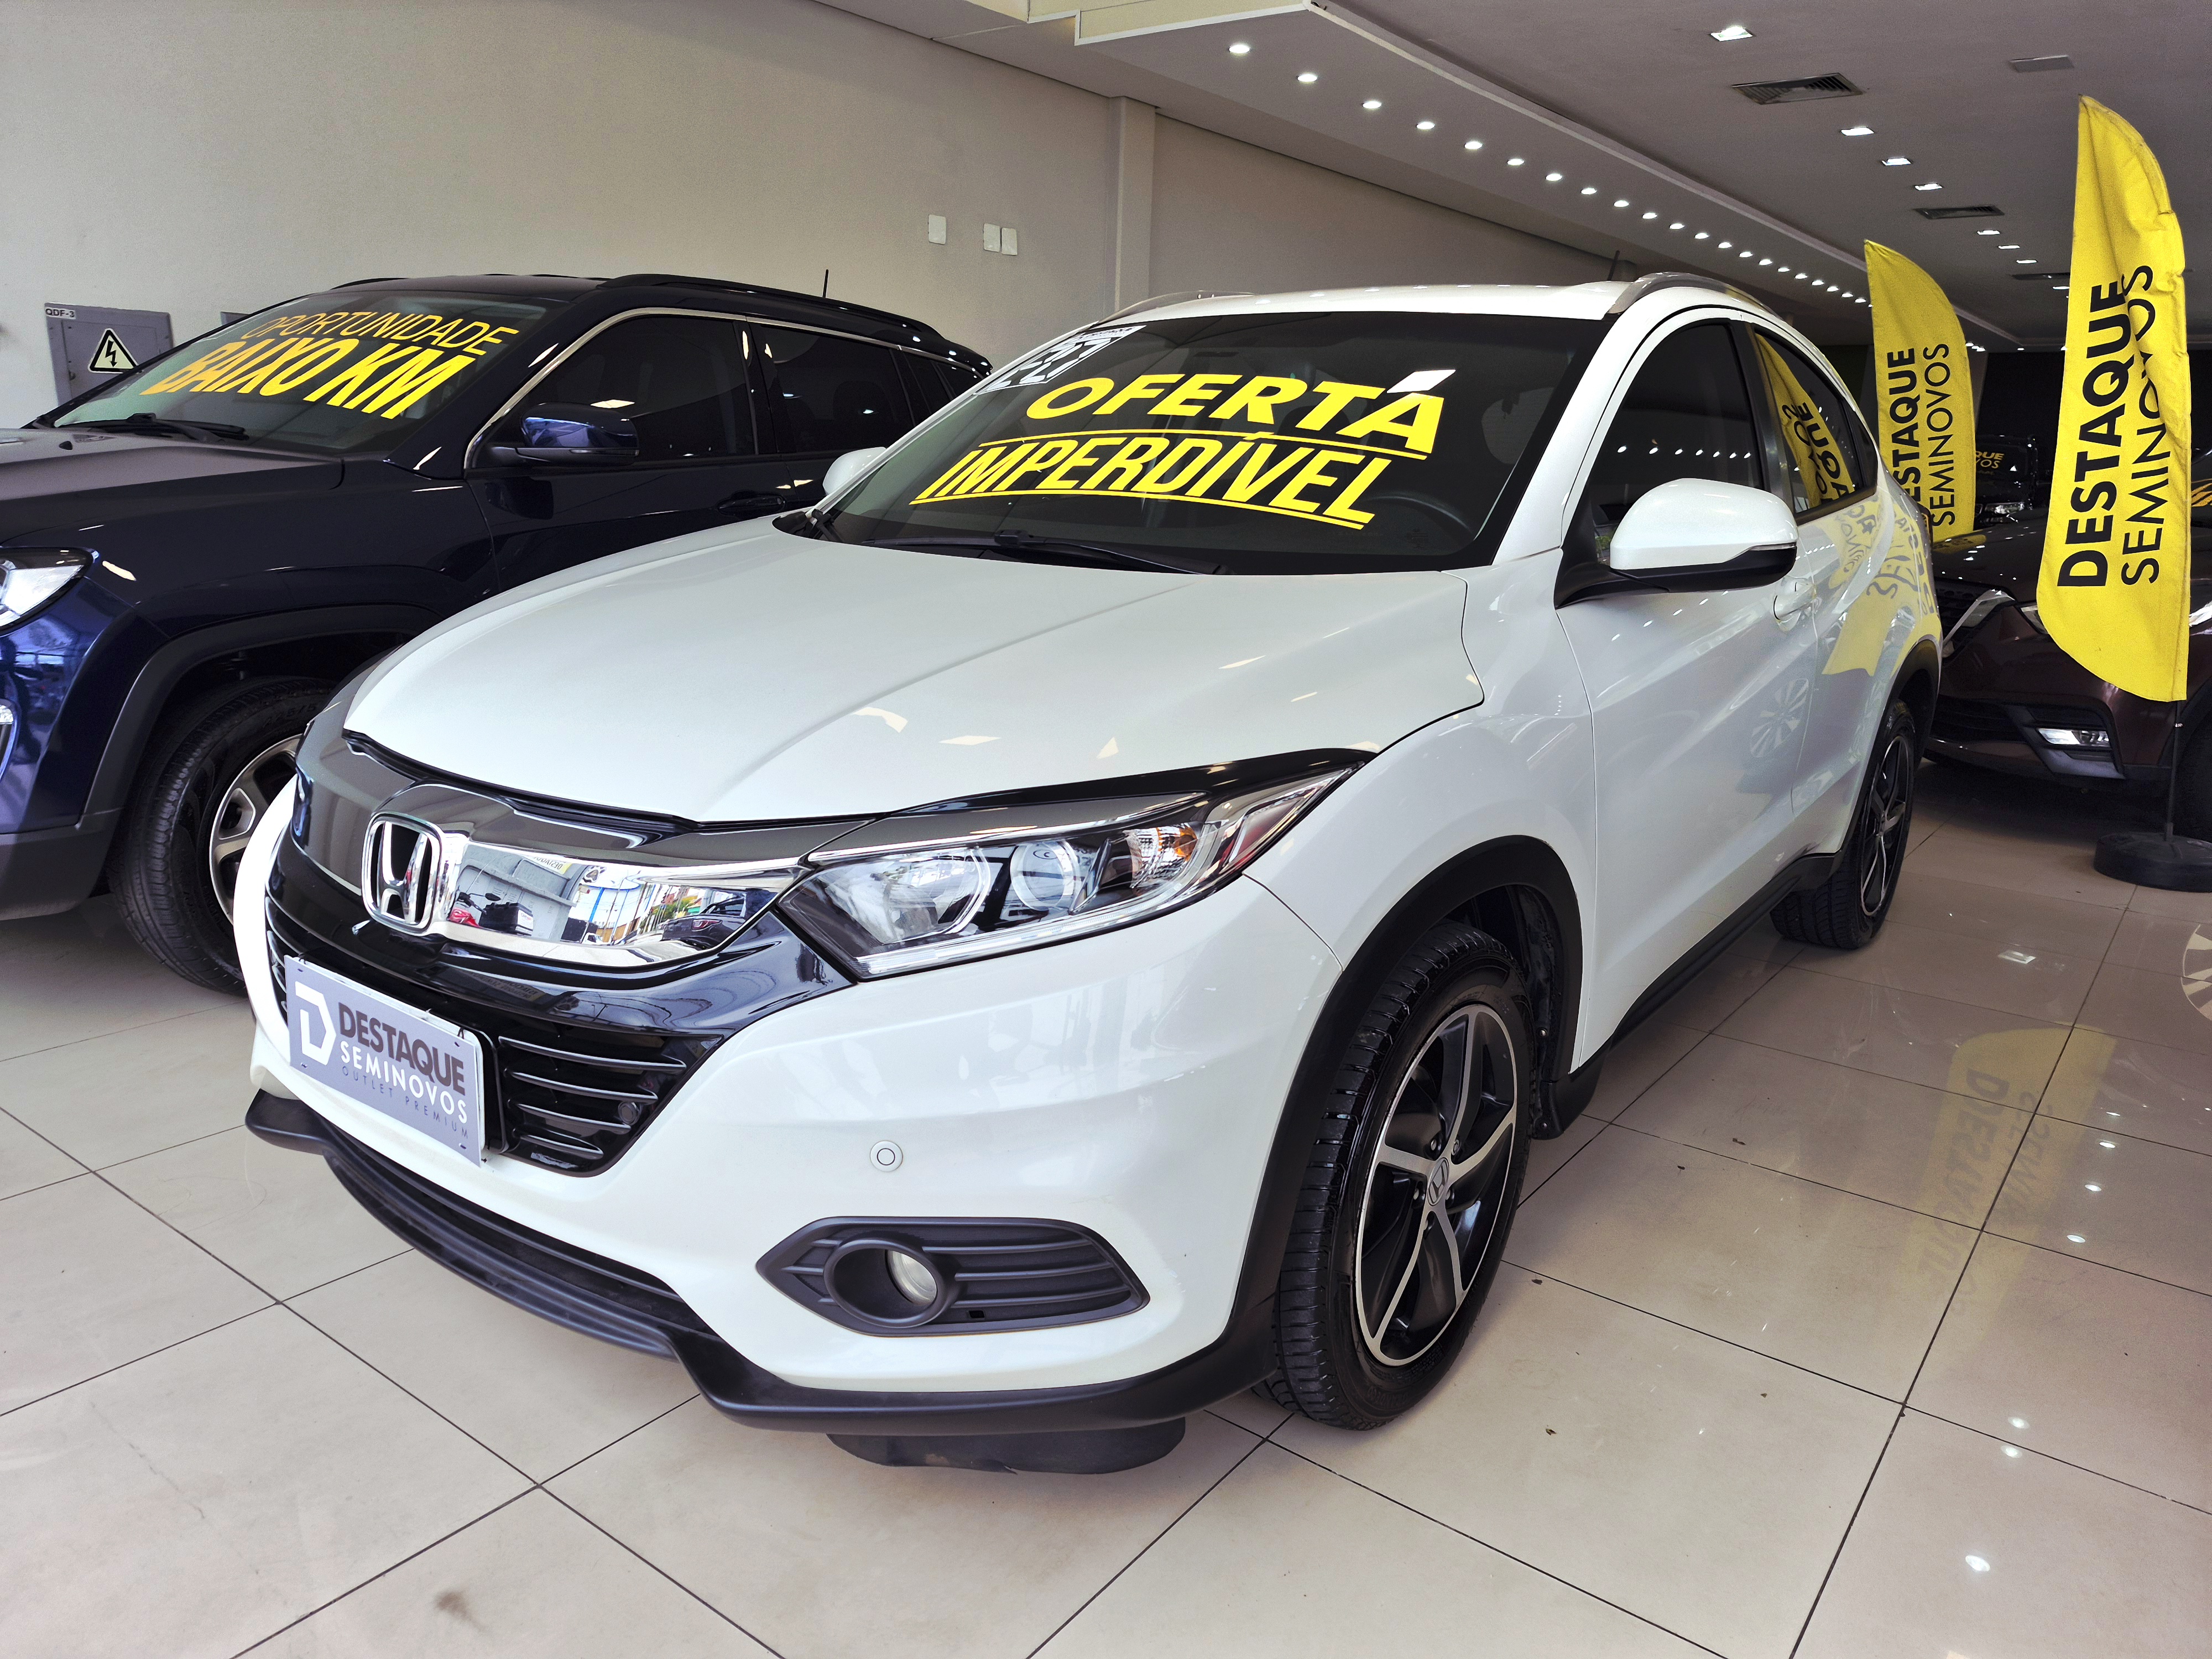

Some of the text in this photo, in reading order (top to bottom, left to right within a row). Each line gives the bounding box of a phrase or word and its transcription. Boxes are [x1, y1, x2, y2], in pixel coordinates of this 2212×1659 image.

[45, 308, 75, 318] QDF-3
[241, 311, 520, 356] OPORTUNIDADE
[139, 338, 476, 420] BAIXO KM
[1026, 373, 1445, 454] OFERTA
[1887, 347, 1921, 502] ESTAQUE
[1923, 342, 1956, 526] SEMINOVOS
[2057, 279, 2135, 587] DESTAQUE
[919, 432, 1392, 524] IMPERDÍVEL
[338, 1001, 466, 1096] DESTAQUE
[340, 1041, 468, 1124] SEMINOVOS
[342, 1066, 468, 1139] OUTLET PREMIUM
